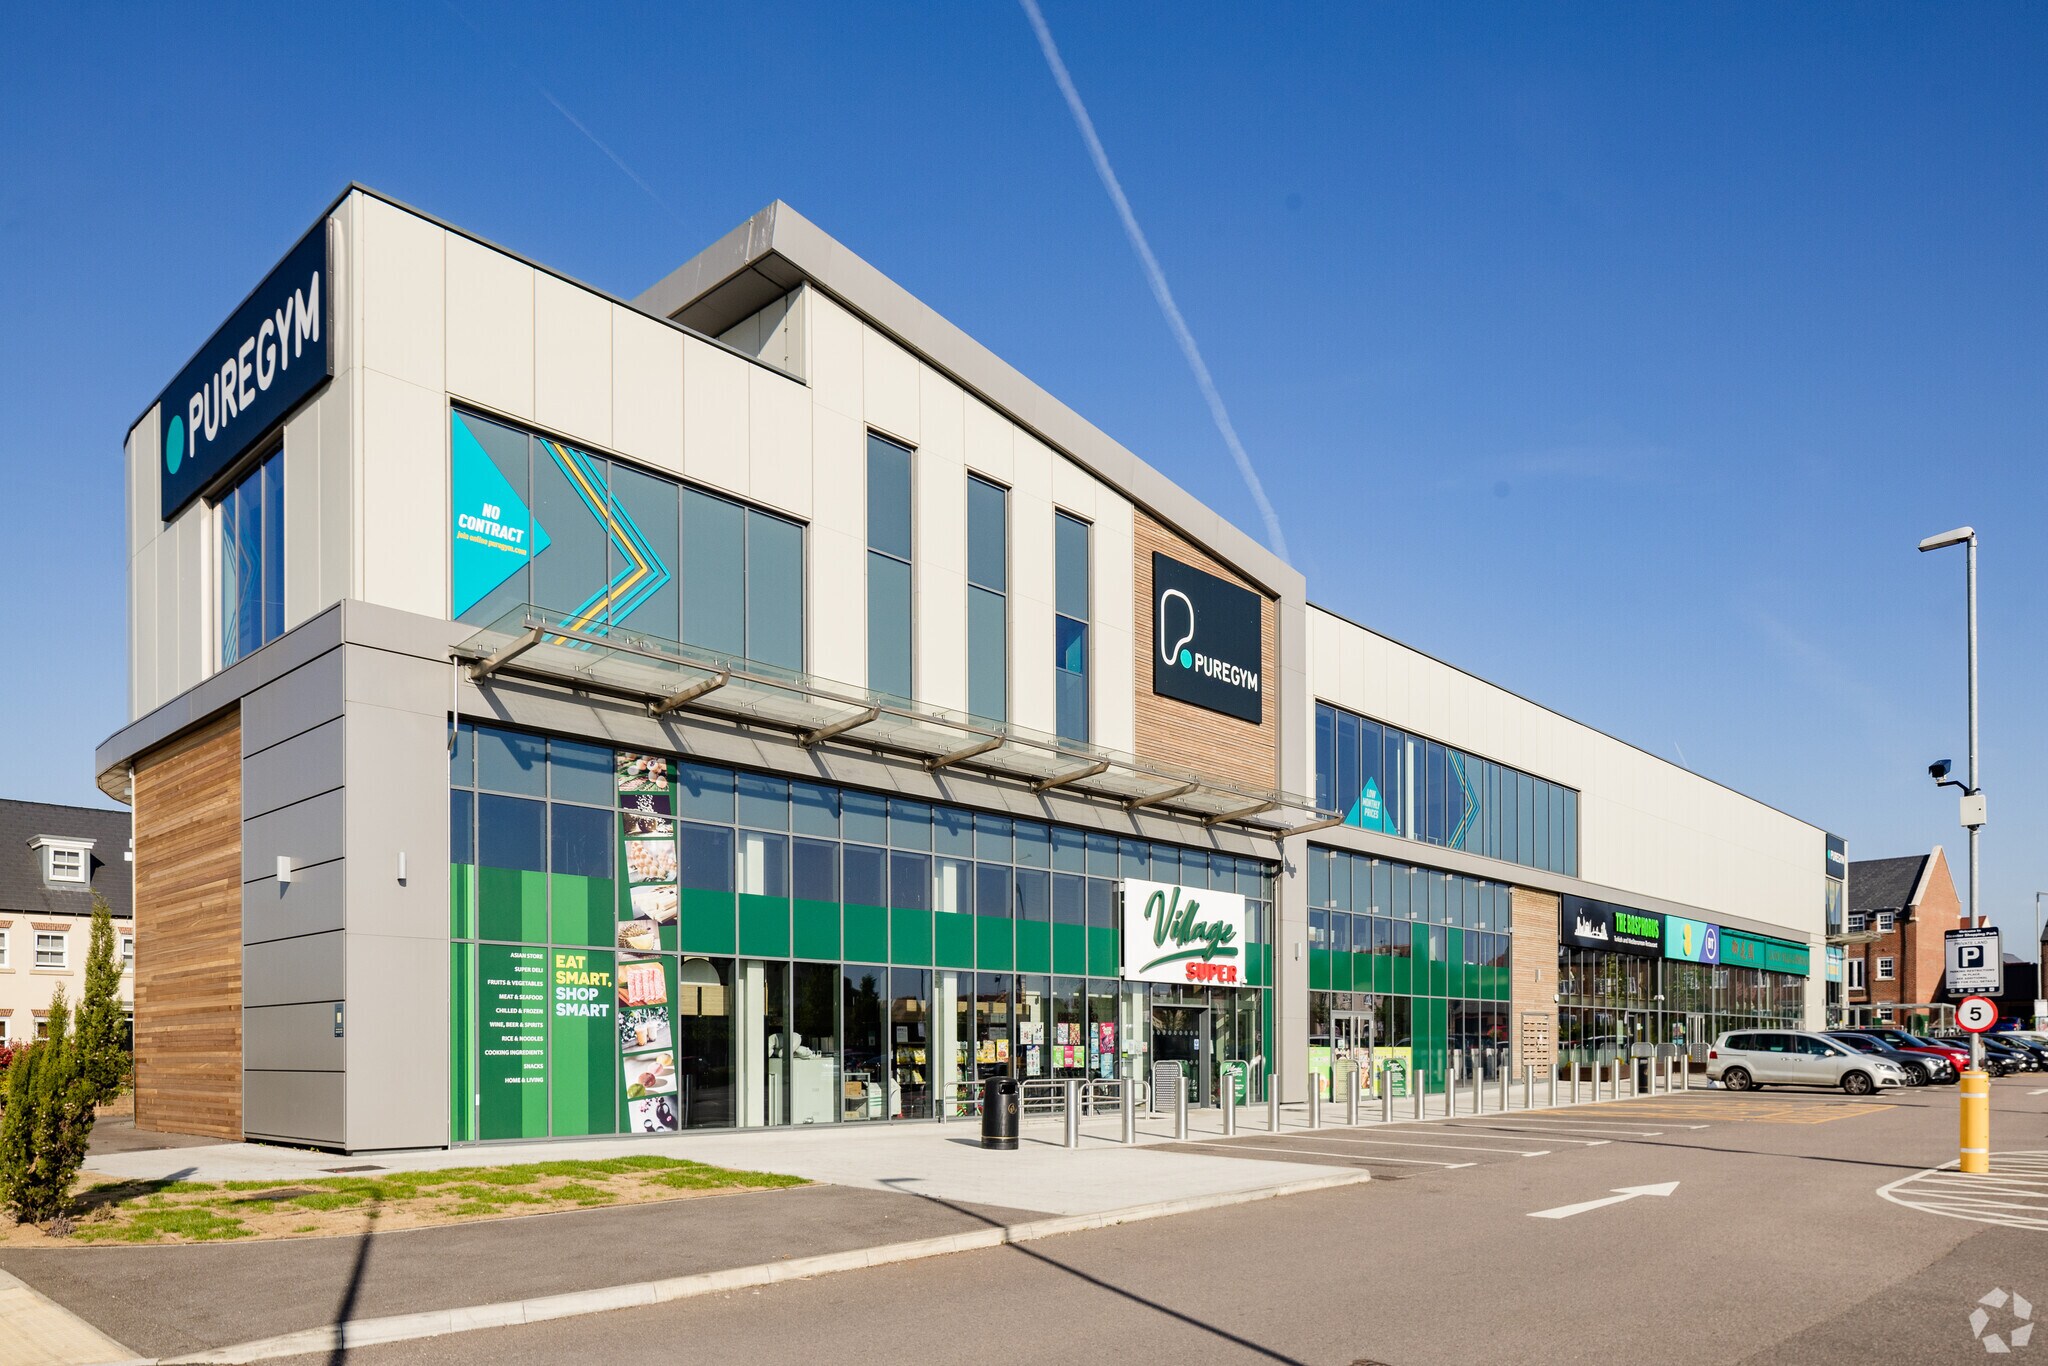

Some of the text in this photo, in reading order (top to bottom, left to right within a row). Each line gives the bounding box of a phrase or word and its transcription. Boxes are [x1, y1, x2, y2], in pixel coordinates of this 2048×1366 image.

[187, 270, 321, 459] PUREGYM
[482, 502, 501, 520] NO
[458, 513, 525, 543] CONTRACT
[1195, 652, 1258, 692] PUREGYM
[1143, 886, 1237, 963] Village
[1615, 911, 1660, 939] THE BOSPHORUS
[555, 954, 586, 969] EAT
[1962, 946, 1980, 967] P
[555, 970, 612, 988] SMART,
[1185, 962, 1238, 984] SUPER
[555, 986, 599, 1001] SHOP
[555, 1002, 609, 1017] SMART
[1969, 1007, 1982, 1021] 5
